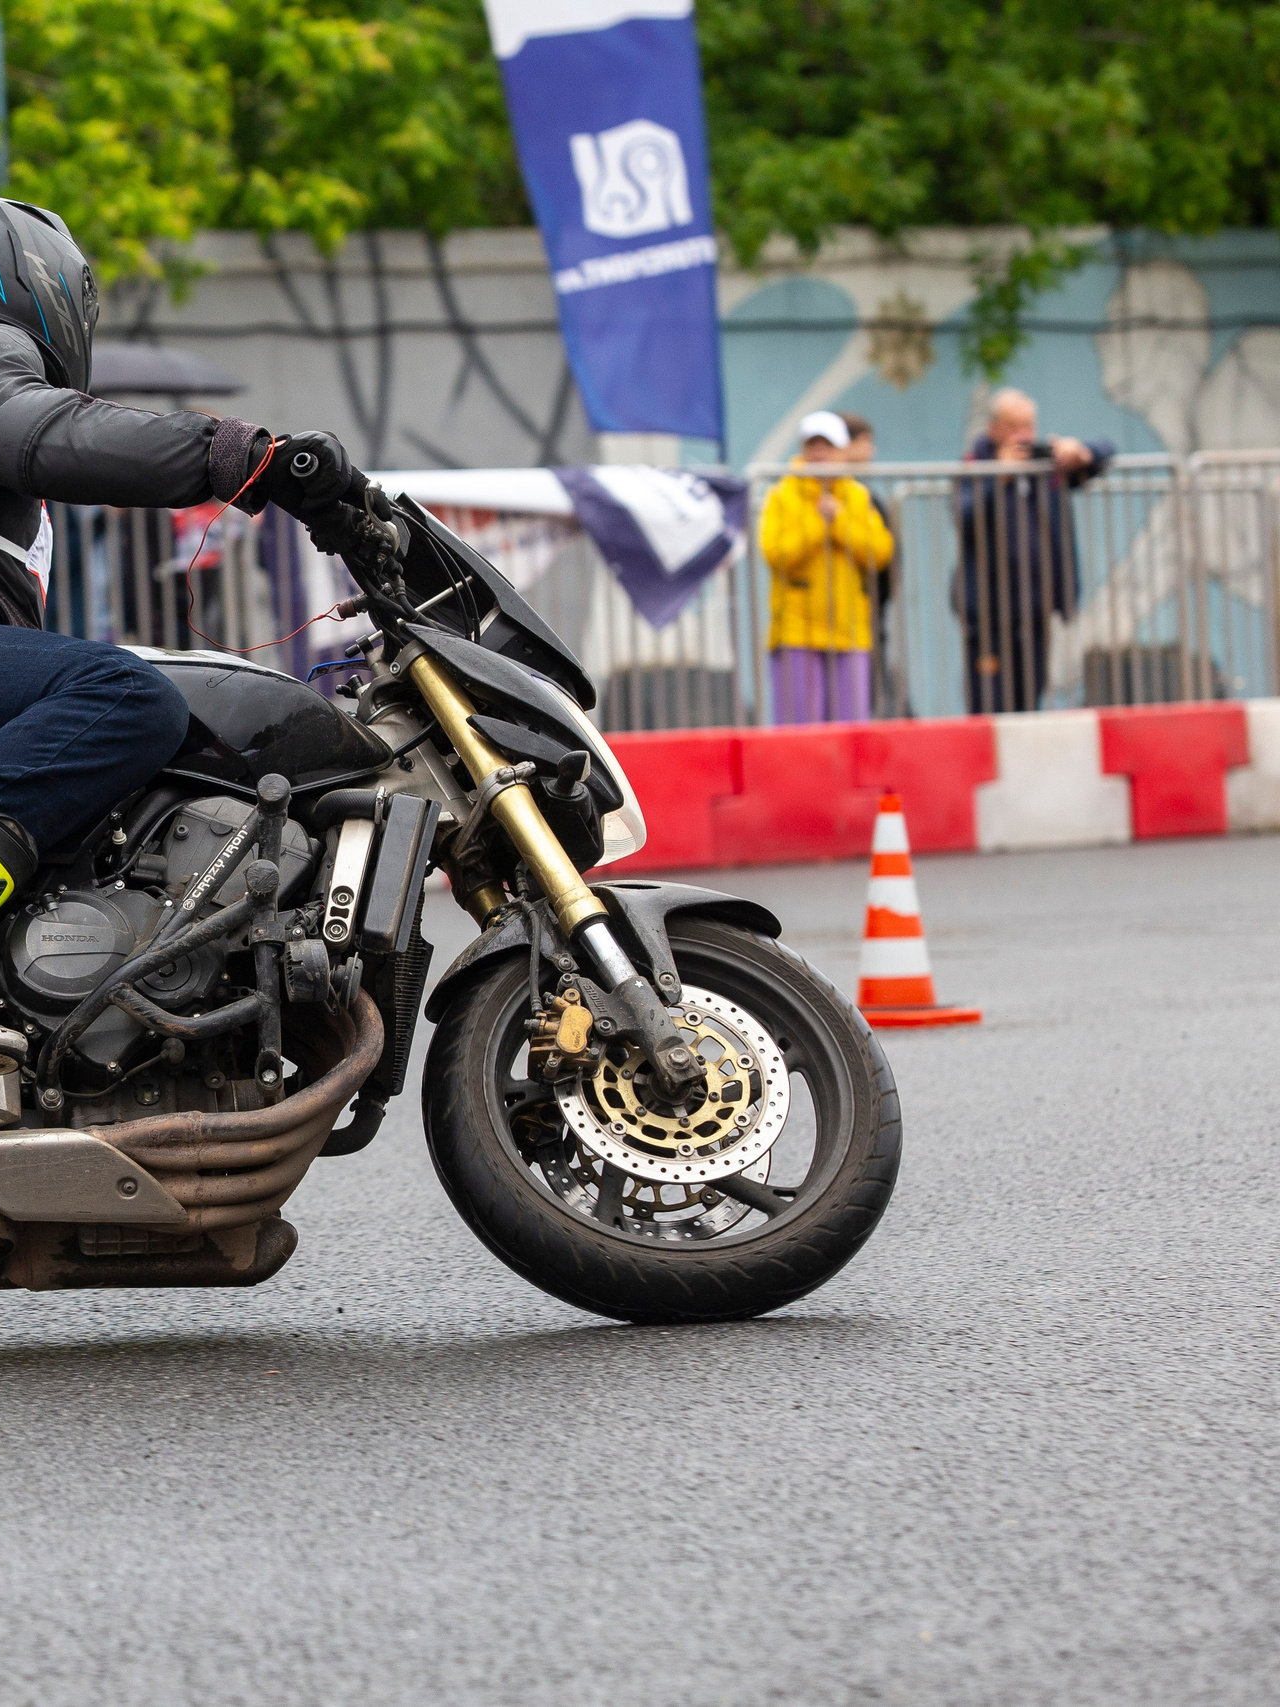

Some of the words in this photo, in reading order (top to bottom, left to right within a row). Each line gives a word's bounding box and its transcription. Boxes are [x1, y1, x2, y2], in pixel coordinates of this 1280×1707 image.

[22, 249, 81, 357] HJC
[191, 858, 226, 899] CRAZY
[41, 934, 100, 943] HONDA
[583, 984, 608, 1014] SHOWA
